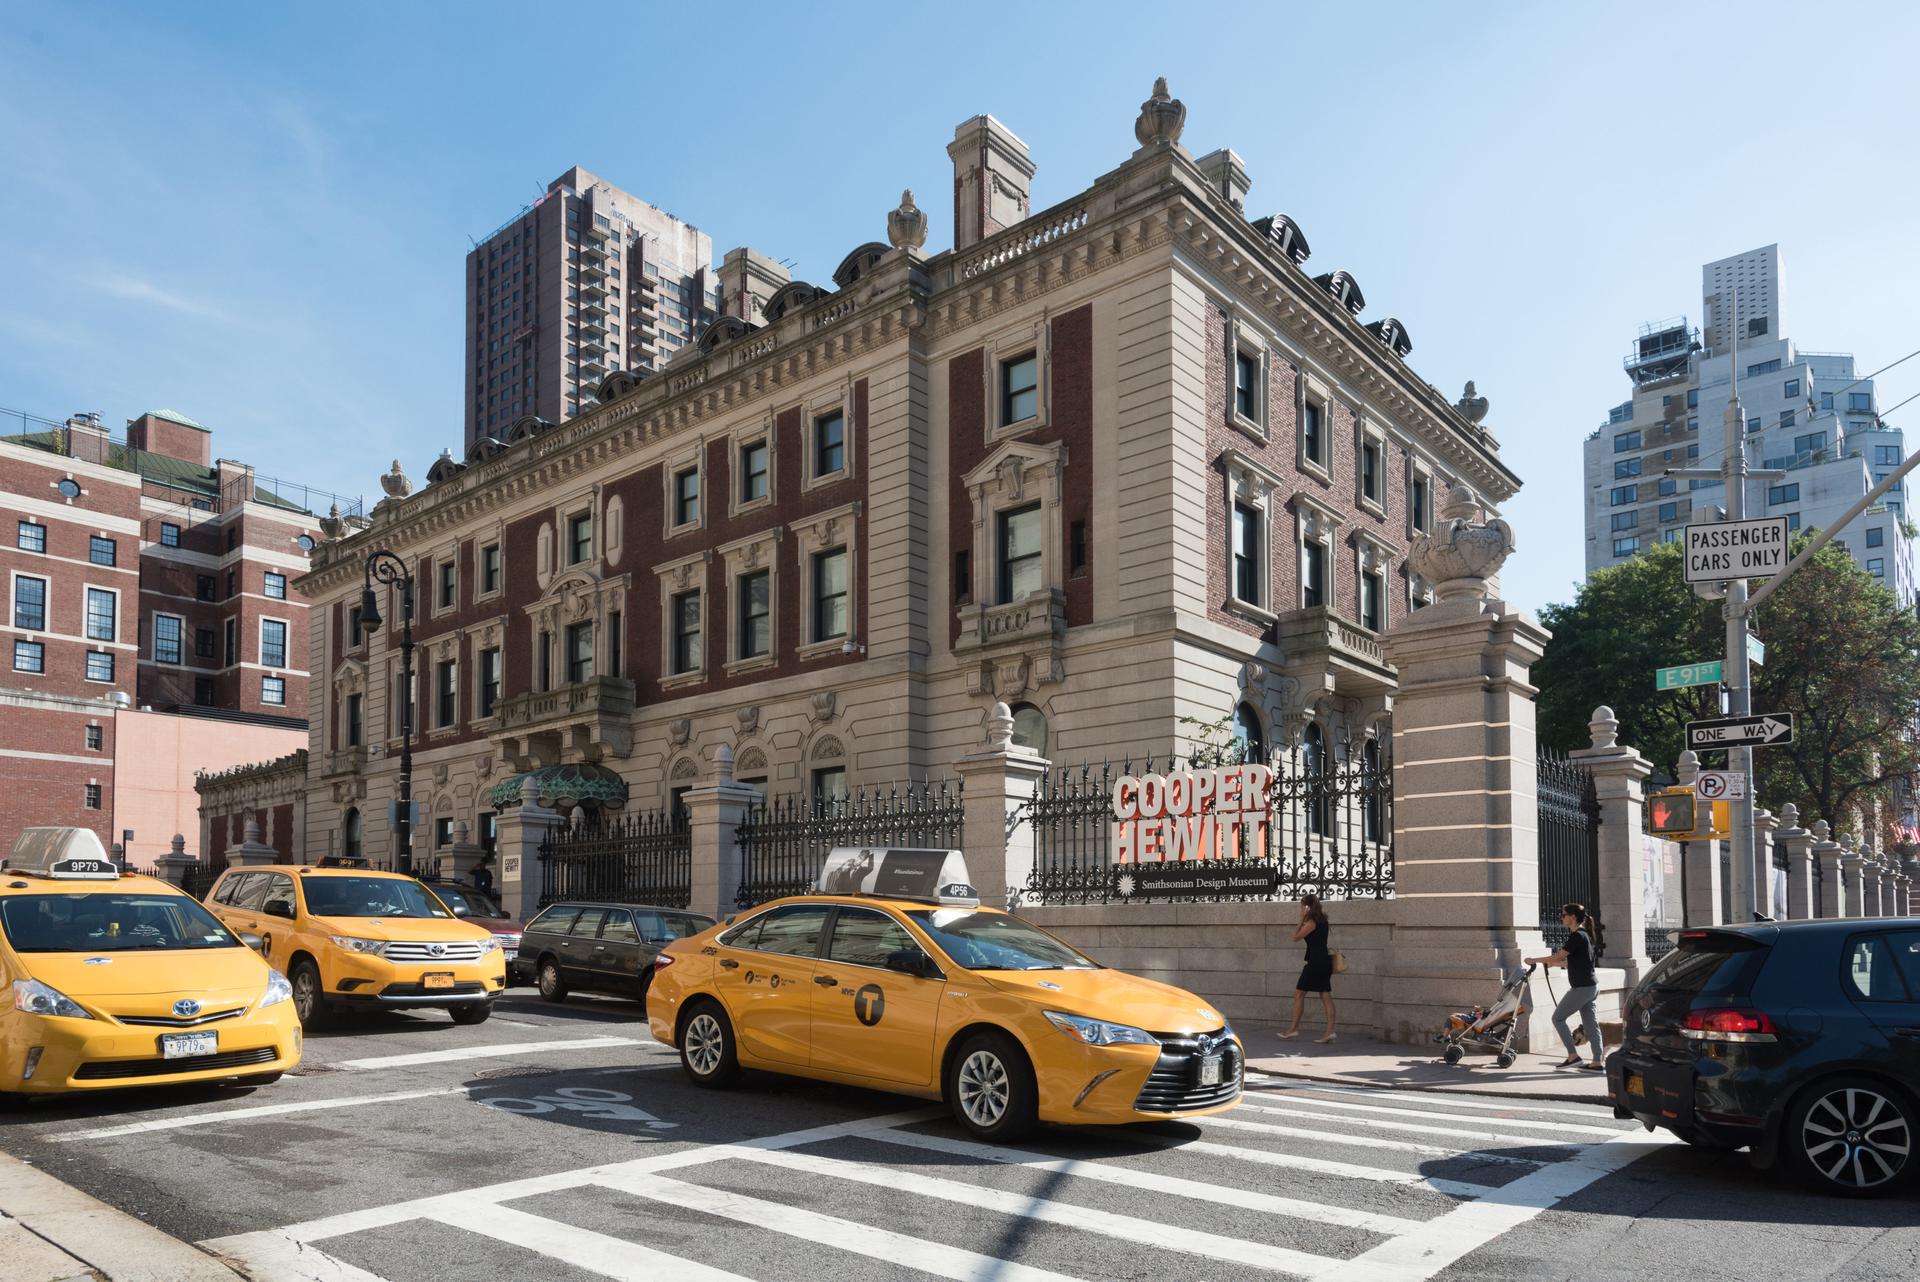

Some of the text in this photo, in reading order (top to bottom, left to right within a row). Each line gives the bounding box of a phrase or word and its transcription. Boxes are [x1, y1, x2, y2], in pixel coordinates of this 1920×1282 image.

[1691, 525, 1780, 549] PASSENGER
[1691, 548, 1780, 571] CARS ONLY
[1665, 670, 1677, 687] E
[1696, 723, 1777, 742] ONE WAY
[1113, 764, 1271, 819] COOPER
[1111, 811, 1269, 864] HEWITT
[71, 861, 99, 872] 9P79
[950, 885, 968, 897] 4P56
[1141, 876, 1268, 891] Smithsonian Design Museum
[841, 988, 855, 997] NYC
[862, 991, 879, 1021] T
